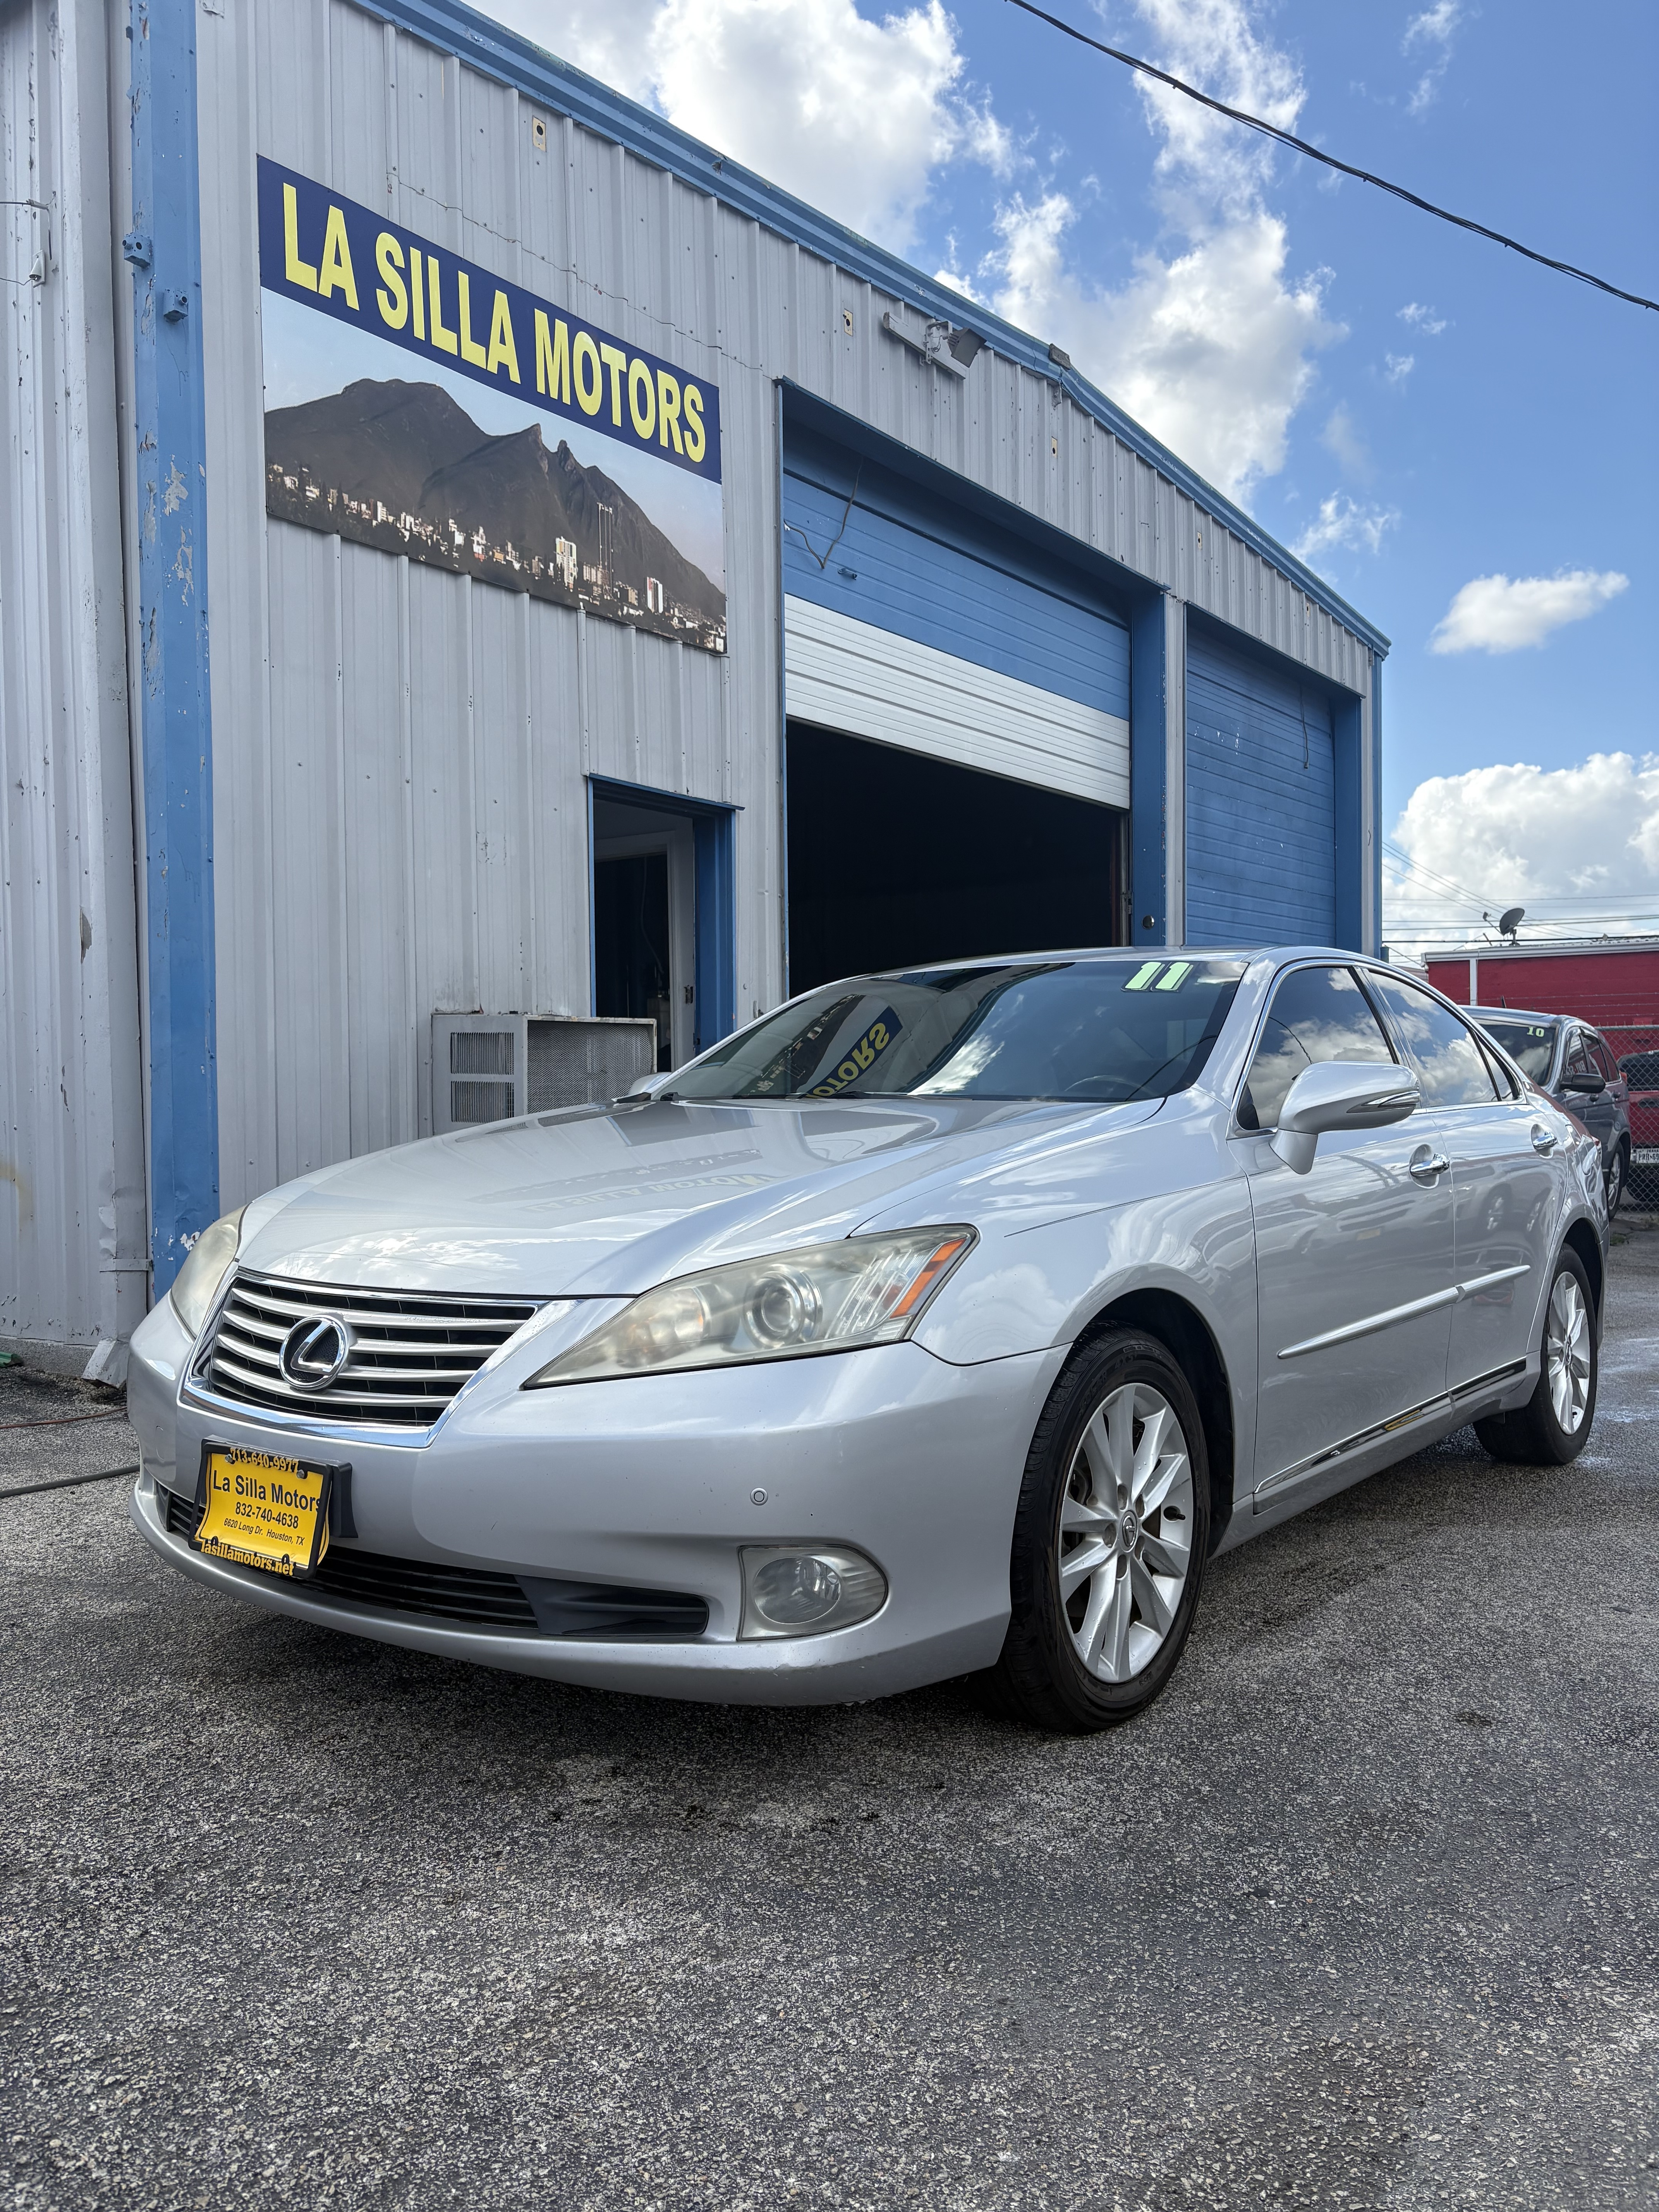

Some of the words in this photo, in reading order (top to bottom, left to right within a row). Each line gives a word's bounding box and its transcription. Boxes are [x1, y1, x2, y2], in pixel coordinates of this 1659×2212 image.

[283, 182, 359, 311] LA
[375, 232, 521, 385] SILLA
[534, 307, 706, 462] MOTORS
[1125, 961, 1190, 989] 11
[1527, 1027, 1544, 1037] 10
[230, 1448, 299, 1472] 713-640-9977
[213, 1470, 230, 1492] La
[235, 1475, 266, 1501] Silla
[235, 1501, 299, 1529] 832-740-4638
[224, 1518, 237, 1529] 6620
[238, 1522, 254, 1535] Long
[254, 1526, 263, 1535] Dr.
[266, 1529, 294, 1544] Houston,
[296, 1535, 306, 1546] TX
[201, 1540, 294, 1576] lasillamotors.net
